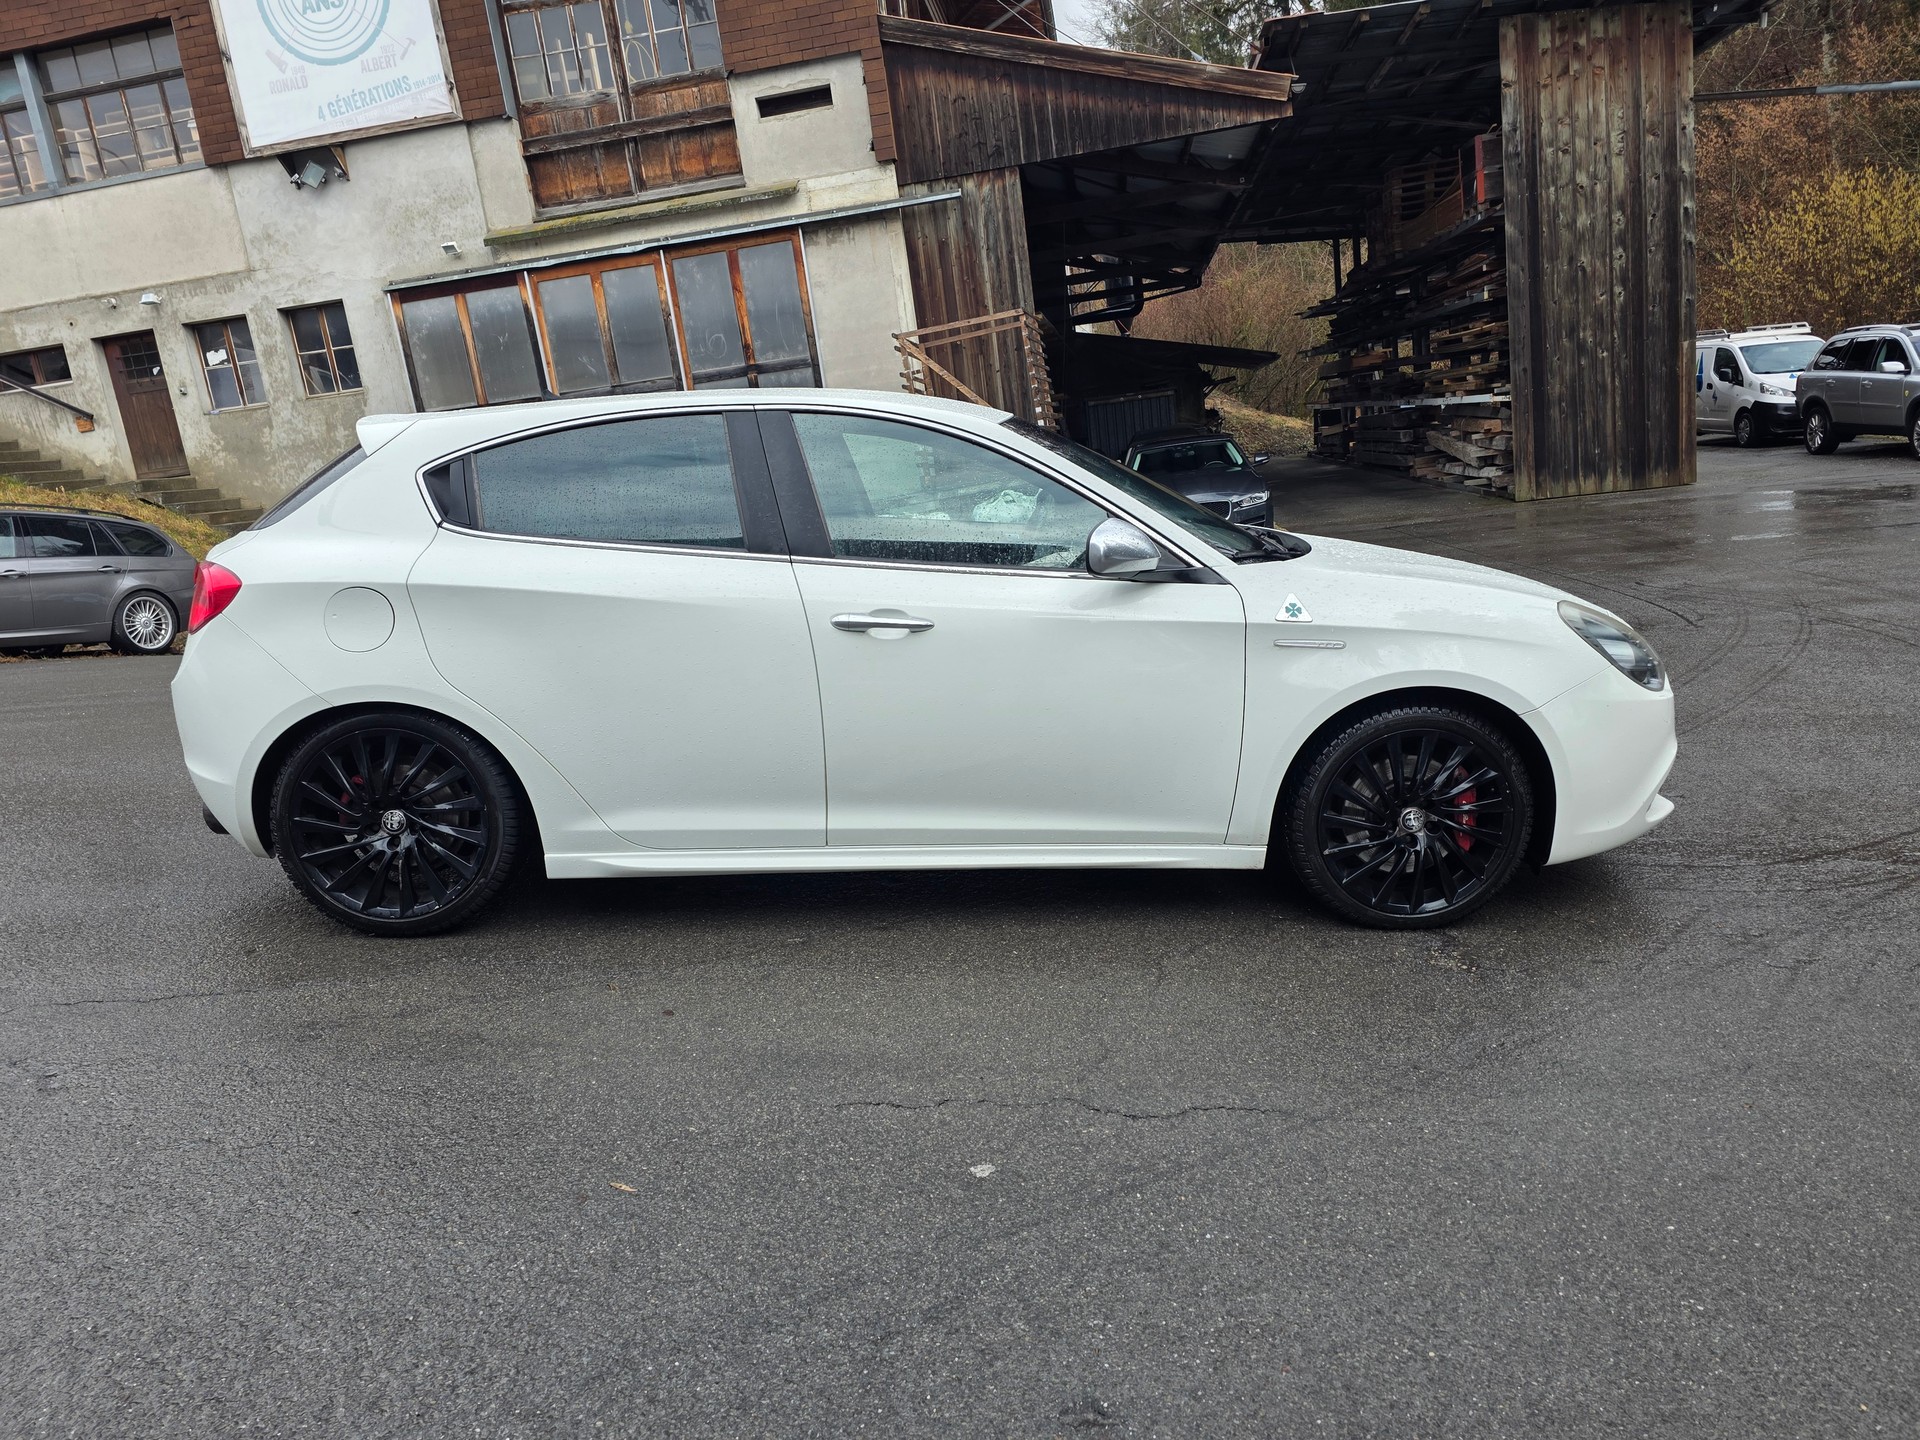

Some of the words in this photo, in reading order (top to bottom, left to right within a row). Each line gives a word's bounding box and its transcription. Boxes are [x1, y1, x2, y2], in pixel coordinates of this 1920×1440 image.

[380, 44, 395, 55] 1922
[360, 54, 397, 74] ALBERT
[270, 76, 309, 95] RONALD
[318, 105, 327, 122] 4
[327, 75, 412, 119] GÉNÉRATIONS
[413, 73, 442, 90] 1914-2014
